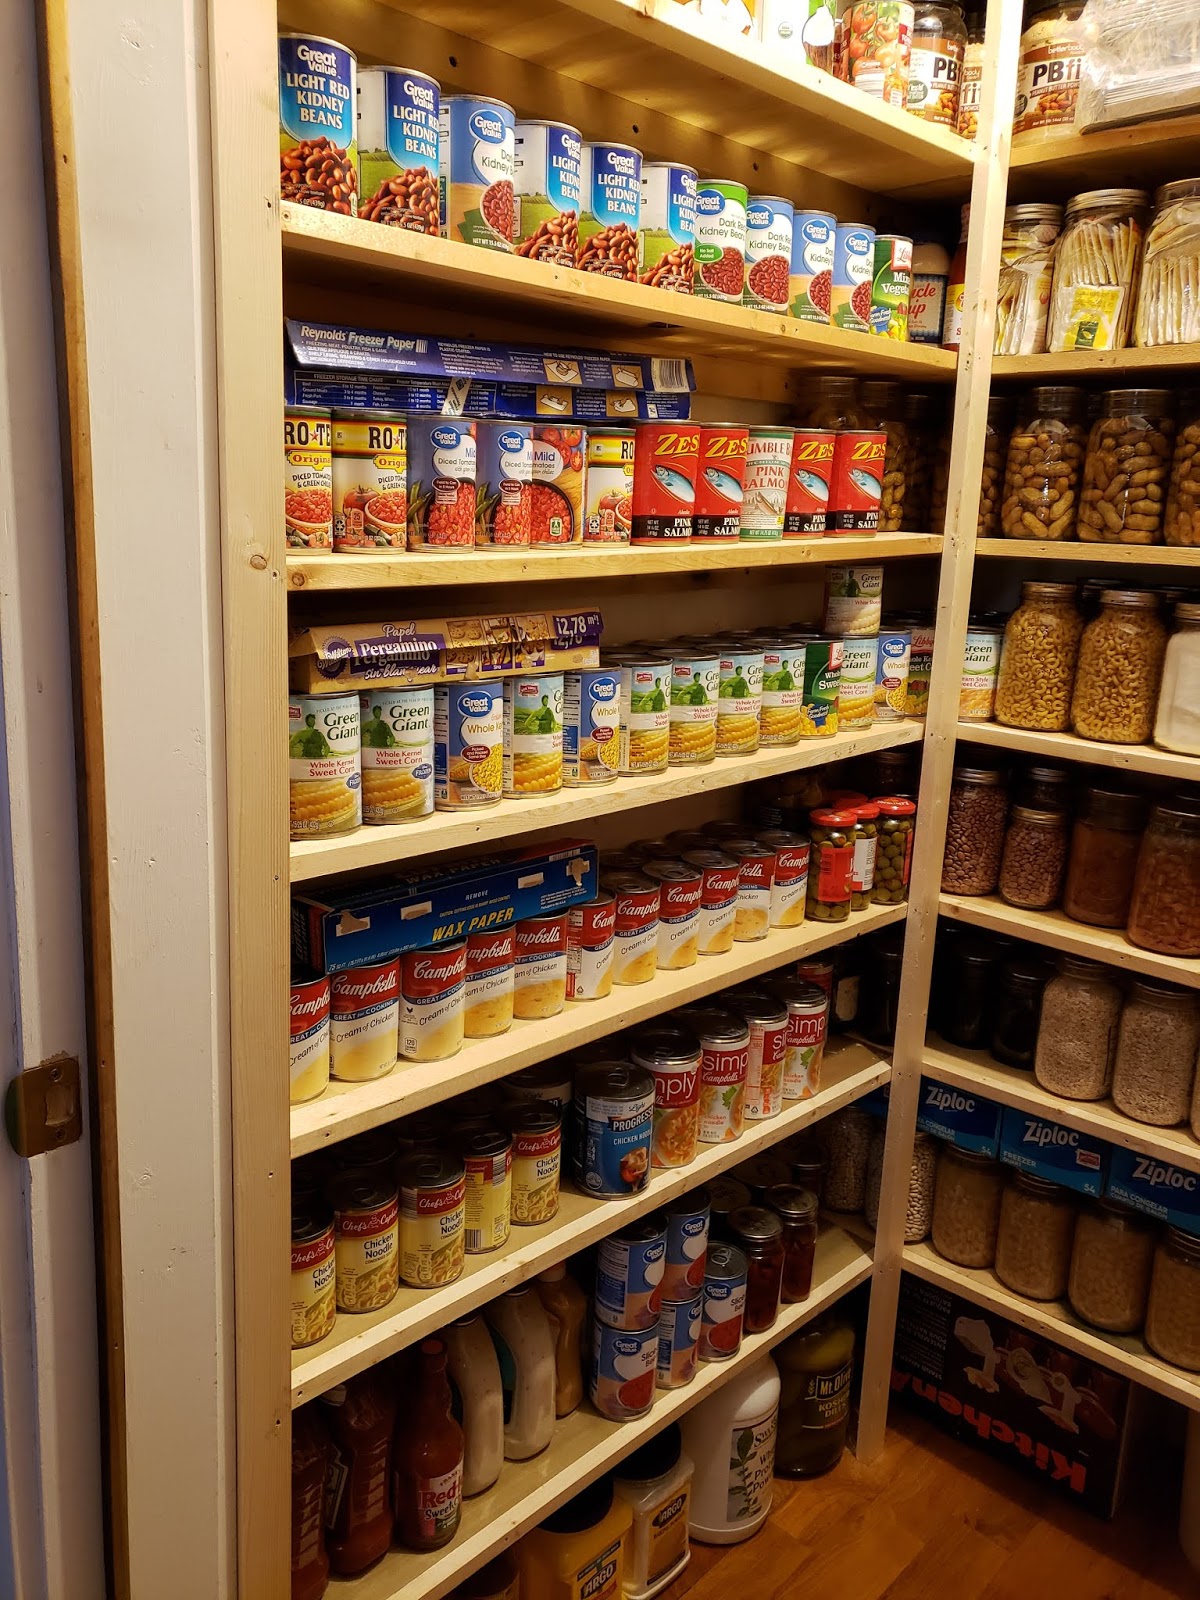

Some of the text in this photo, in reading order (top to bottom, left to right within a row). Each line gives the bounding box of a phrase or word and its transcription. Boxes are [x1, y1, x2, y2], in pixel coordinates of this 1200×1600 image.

[297, 45, 336, 66] Great
[308, 61, 336, 77] Value
[286, 73, 349, 100] LIGHT RED
[403, 80, 434, 99] Great
[297, 91, 344, 114] KIDNEY
[412, 97, 434, 112] Value
[300, 108, 342, 129] BEANS
[394, 105, 426, 125] LIGHT
[474, 116, 502, 133] Great
[402, 122, 438, 145] KIDNEY
[481, 128, 502, 139] Value
[405, 139, 437, 160] BEANS
[481, 156, 509, 175] Kidney
[552, 155, 576, 171] LIGHT
[607, 152, 635, 168] Great
[615, 164, 635, 176] Value
[598, 173, 641, 192] LIGHT RED
[605, 187, 638, 203] KIDNEY
[696, 196, 720, 206] Great
[607, 200, 636, 216] BEANS
[746, 210, 770, 221] Great
[749, 217, 770, 226] Value
[719, 217, 737, 229] Dark
[699, 225, 729, 239] Kidney
[768, 232, 784, 242] Dark
[749, 240, 778, 252] Kidney
[810, 253, 831, 267] Kidney
[301, 325, 415, 352] Reynolds Freezer Paper
[434, 431, 456, 441] Great
[534, 451, 556, 462] Mild
[292, 473, 311, 482] DICED
[756, 466, 785, 476] PINK
[302, 480, 320, 488] GREEN
[378, 476, 394, 484] DICED
[382, 622, 416, 641] Papel
[359, 638, 438, 657] Pergamino
[364, 668, 381, 680] sin
[593, 683, 614, 693] Great
[463, 697, 488, 708] Great
[469, 704, 489, 713] Value
[389, 705, 430, 719] Green
[597, 708, 618, 717] Whole
[693, 712, 710, 720] Sweet
[324, 712, 359, 727] Green
[393, 718, 429, 732] Giant
[327, 724, 359, 741] Giant
[467, 724, 495, 734] Whole
[376, 756, 423, 765] Sweet Corn
[377, 749, 422, 758] Whole Kernel
[310, 758, 354, 769] Whole Kernel
[309, 765, 355, 777] Sweet Corn
[465, 890, 489, 900] REMOVE
[781, 887, 798, 902] Cream
[432, 907, 514, 942] WAX PAPER
[709, 911, 727, 927] Cream
[670, 925, 689, 941] Cream
[621, 941, 642, 955] Cream
[529, 952, 557, 962] COOKING
[329, 963, 337, 971] 75
[532, 963, 558, 975] Chicken
[332, 971, 397, 998] Campbell's
[479, 976, 510, 993] of Chicken
[417, 996, 439, 1005] GREAT
[334, 1000, 394, 1021] GREAT COOKING
[419, 1002, 451, 1026] Cream of
[336, 1011, 395, 1042] Cream of Chicken
[290, 1044, 314, 1066] Cream
[925, 1085, 976, 1112] Ziploc
[613, 1134, 638, 1146] CHICKEN
[1023, 1120, 1080, 1147] Ziploc
[518, 1139, 541, 1152] Chef's
[536, 1154, 559, 1168] Chicken
[1003, 1150, 1037, 1168] FREEZER
[537, 1163, 559, 1177] Noodle
[1132, 1157, 1197, 1192] Ziploc
[1083, 1183, 1096, 1194] 54
[419, 1196, 443, 1208] Chef's
[1110, 1185, 1168, 1214] PARA CONGELAR
[342, 1216, 368, 1232] Chef's
[441, 1219, 464, 1235] Noodle
[684, 1219, 705, 1231] Great
[363, 1233, 394, 1250] Chicken
[290, 1248, 316, 1264] Chef's
[366, 1243, 393, 1260] Noodle
[646, 1245, 664, 1257] Great
[707, 1285, 728, 1294] Great
[615, 1340, 638, 1349] Great
[660, 1497, 682, 1523] ARGO
[584, 1563, 614, 1598] ARGO
